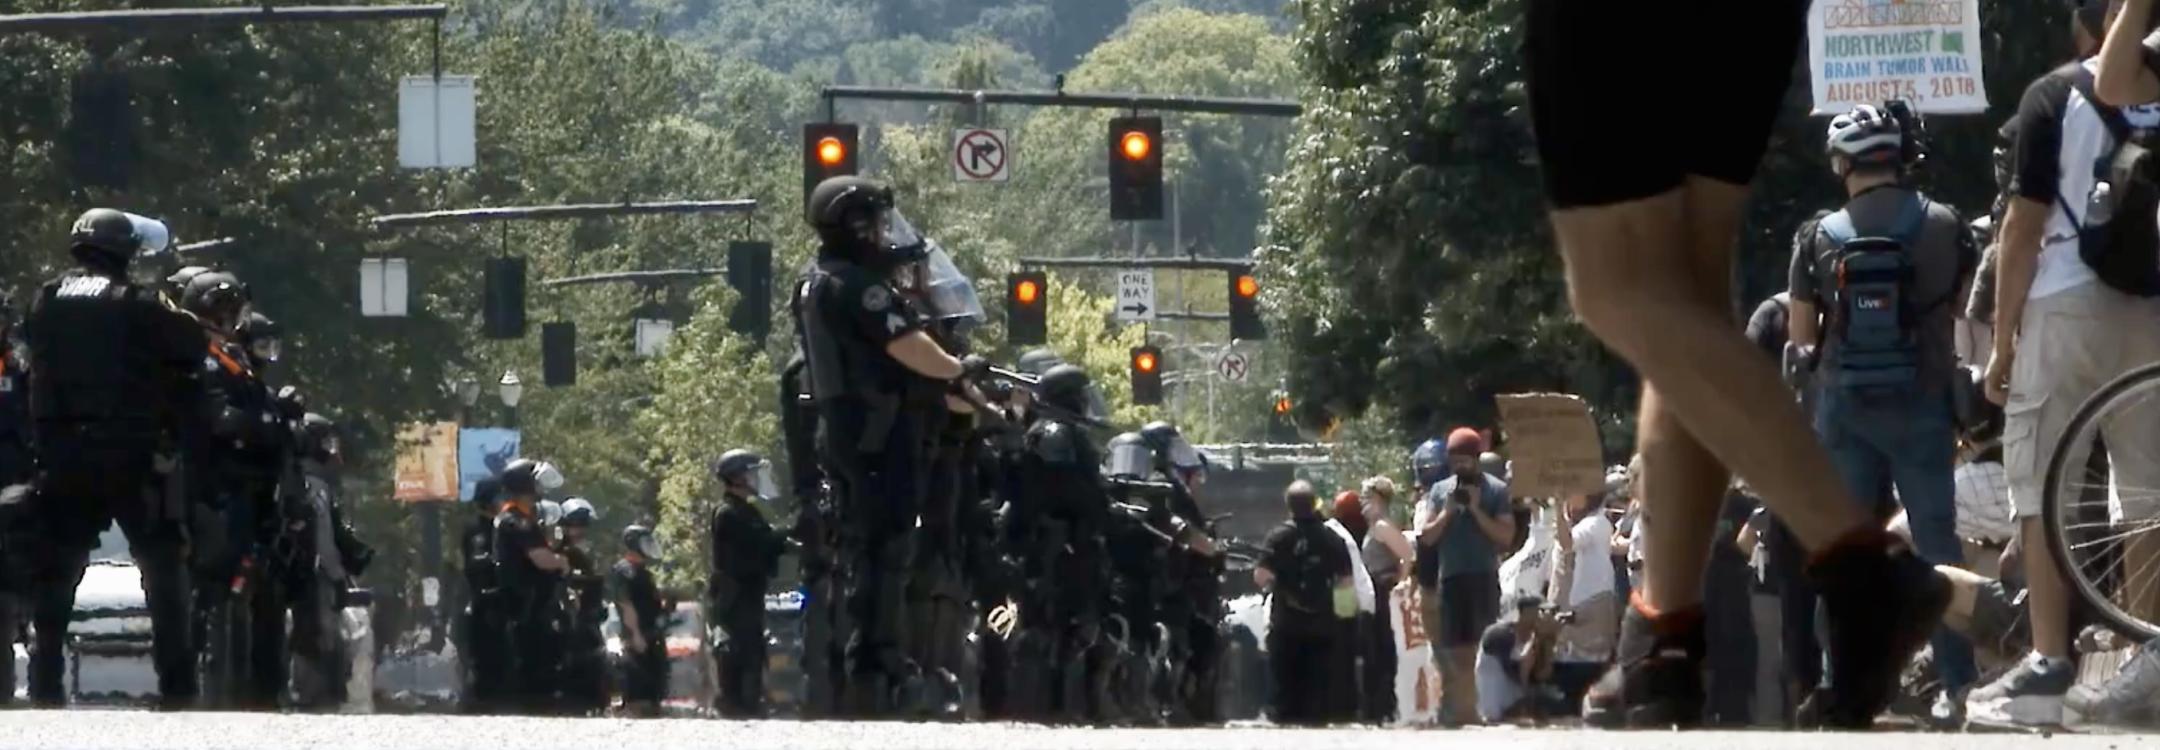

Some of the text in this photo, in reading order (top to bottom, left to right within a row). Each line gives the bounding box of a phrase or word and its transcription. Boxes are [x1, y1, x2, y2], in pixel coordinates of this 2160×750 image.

[1824, 30, 1935, 58] NORTHWEST
[1824, 61, 1871, 79] BRAIN
[1877, 58, 1926, 76] TUMOR
[1827, 80, 1901, 102] AUGUST
[1930, 77, 1975, 98] 2018
[1122, 274, 1148, 286] ONE
[1122, 286, 1150, 299] WAY
